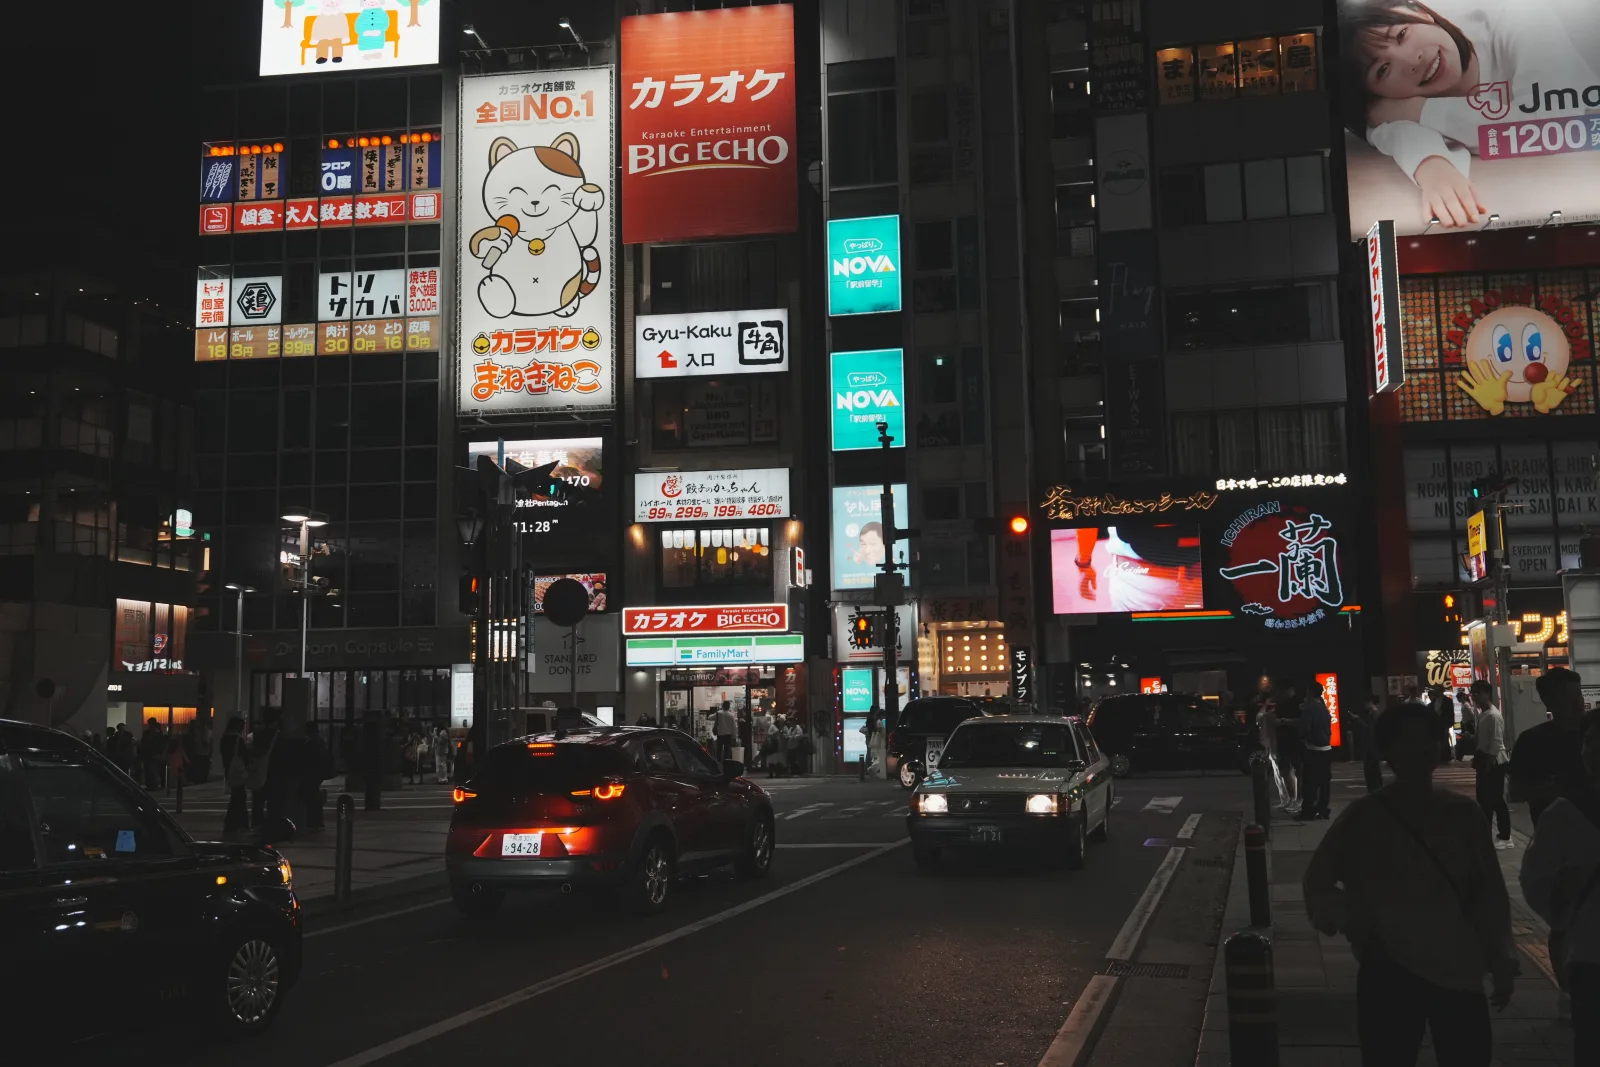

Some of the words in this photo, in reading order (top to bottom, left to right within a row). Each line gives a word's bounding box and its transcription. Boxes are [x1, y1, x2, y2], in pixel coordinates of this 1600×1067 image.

[498, 81, 576, 96] カラオケ店舗数
[629, 70, 786, 110] カラオケ
[642, 128, 686, 140] Karaoke
[690, 123, 772, 137] Entertainment
[1487, 128, 1500, 157] 会員数
[628, 142, 689, 175] BIG
[697, 135, 789, 165] ECHO
[414, 145, 425, 187] 豚バラ串
[833, 255, 897, 278] NOVA
[409, 270, 438, 284] 焼き鳥
[409, 283, 437, 297] 食べ放題
[201, 298, 225, 310] 個室
[328, 295, 400, 318] サカバ
[409, 298, 438, 313] 3,000円
[201, 310, 225, 324] 完備
[1443, 285, 1533, 364] KARAOKE
[642, 324, 733, 344] Gyu-Kaku
[1541, 294, 1591, 360] ROOM
[490, 328, 583, 353] カラオケ
[685, 352, 716, 368] 入口
[472, 359, 603, 401] まねきねこ
[836, 389, 900, 412] NOVA
[1216, 472, 1348, 491] 日本で唯一、この店限定の味
[648, 507, 673, 520] 99円
[675, 506, 709, 519] 299円
[713, 505, 743, 517] 199円
[748, 503, 782, 516] 480円
[1220, 500, 1281, 548] ICHIRAN
[1512, 544, 1552, 555] EVERYDAY
[1220, 513, 1345, 607] 一蘭
[1519, 558, 1547, 571] OPEN
[633, 611, 708, 630] カラオケ
[717, 614, 742, 628] BIG
[744, 612, 780, 626] ECHO
[544, 653, 597, 664] STANARD
[696, 648, 749, 661] FamilyMart
[510, 842, 539, 854] 94-28
